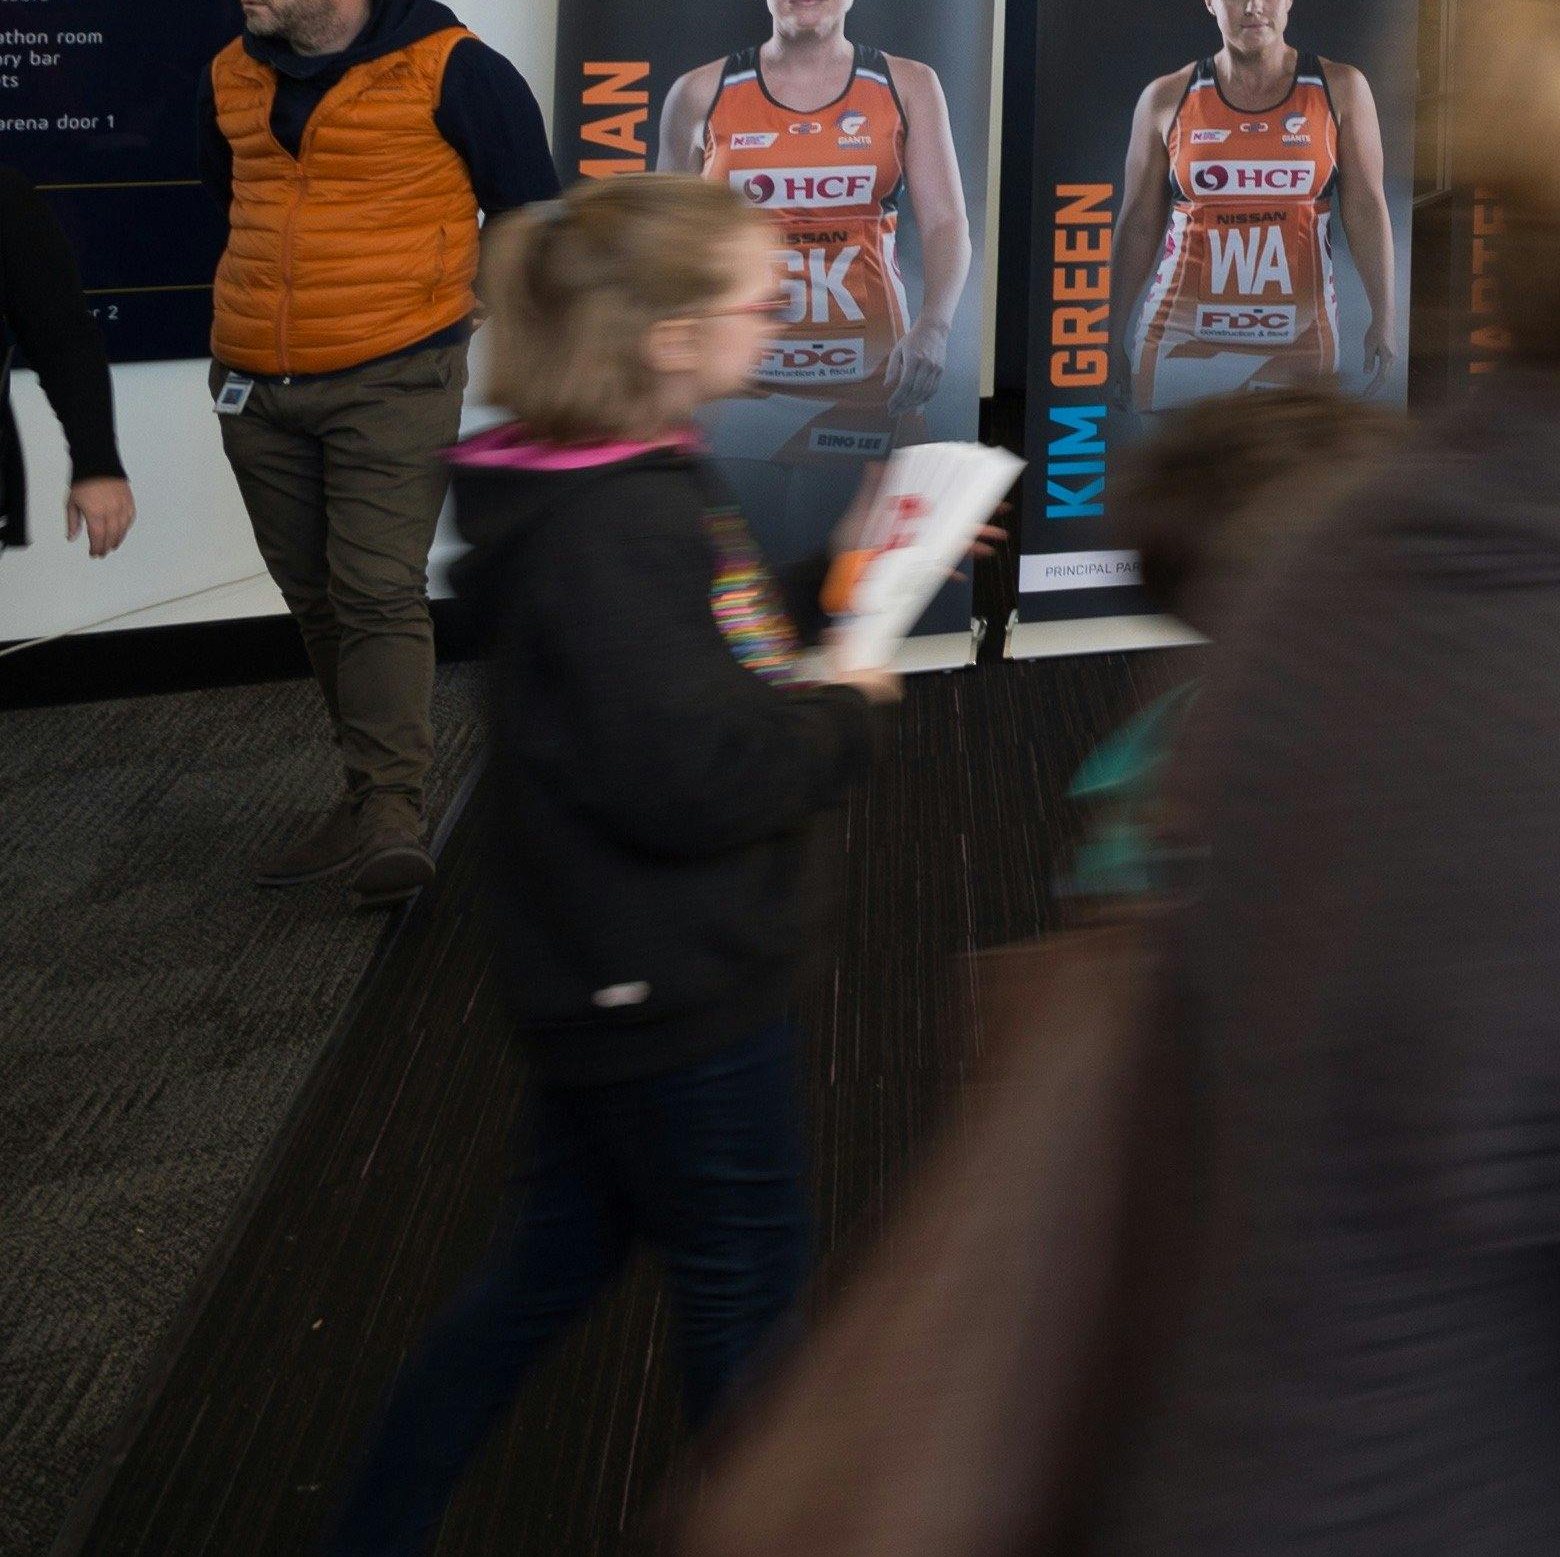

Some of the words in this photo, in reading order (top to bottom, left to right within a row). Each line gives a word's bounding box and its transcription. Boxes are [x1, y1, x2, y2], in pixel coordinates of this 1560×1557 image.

[57, 31, 103, 45] room
[30, 50, 61, 66] bar
[0, 74, 20, 89] ts
[57, 114, 99, 130] door
[107, 114, 115, 129] 1
[1237, 169, 1310, 188] HCF
[784, 176, 871, 200] HCF
[1217, 211, 1287, 224] NISSAN
[786, 230, 849, 244] SSAN
[1208, 225, 1293, 294] WA
[1050, 183, 1114, 387] GREEN
[1202, 312, 1289, 329] FDC
[1046, 405, 1107, 519] KIM
[1045, 564, 1111, 578] PRINCIPAL
